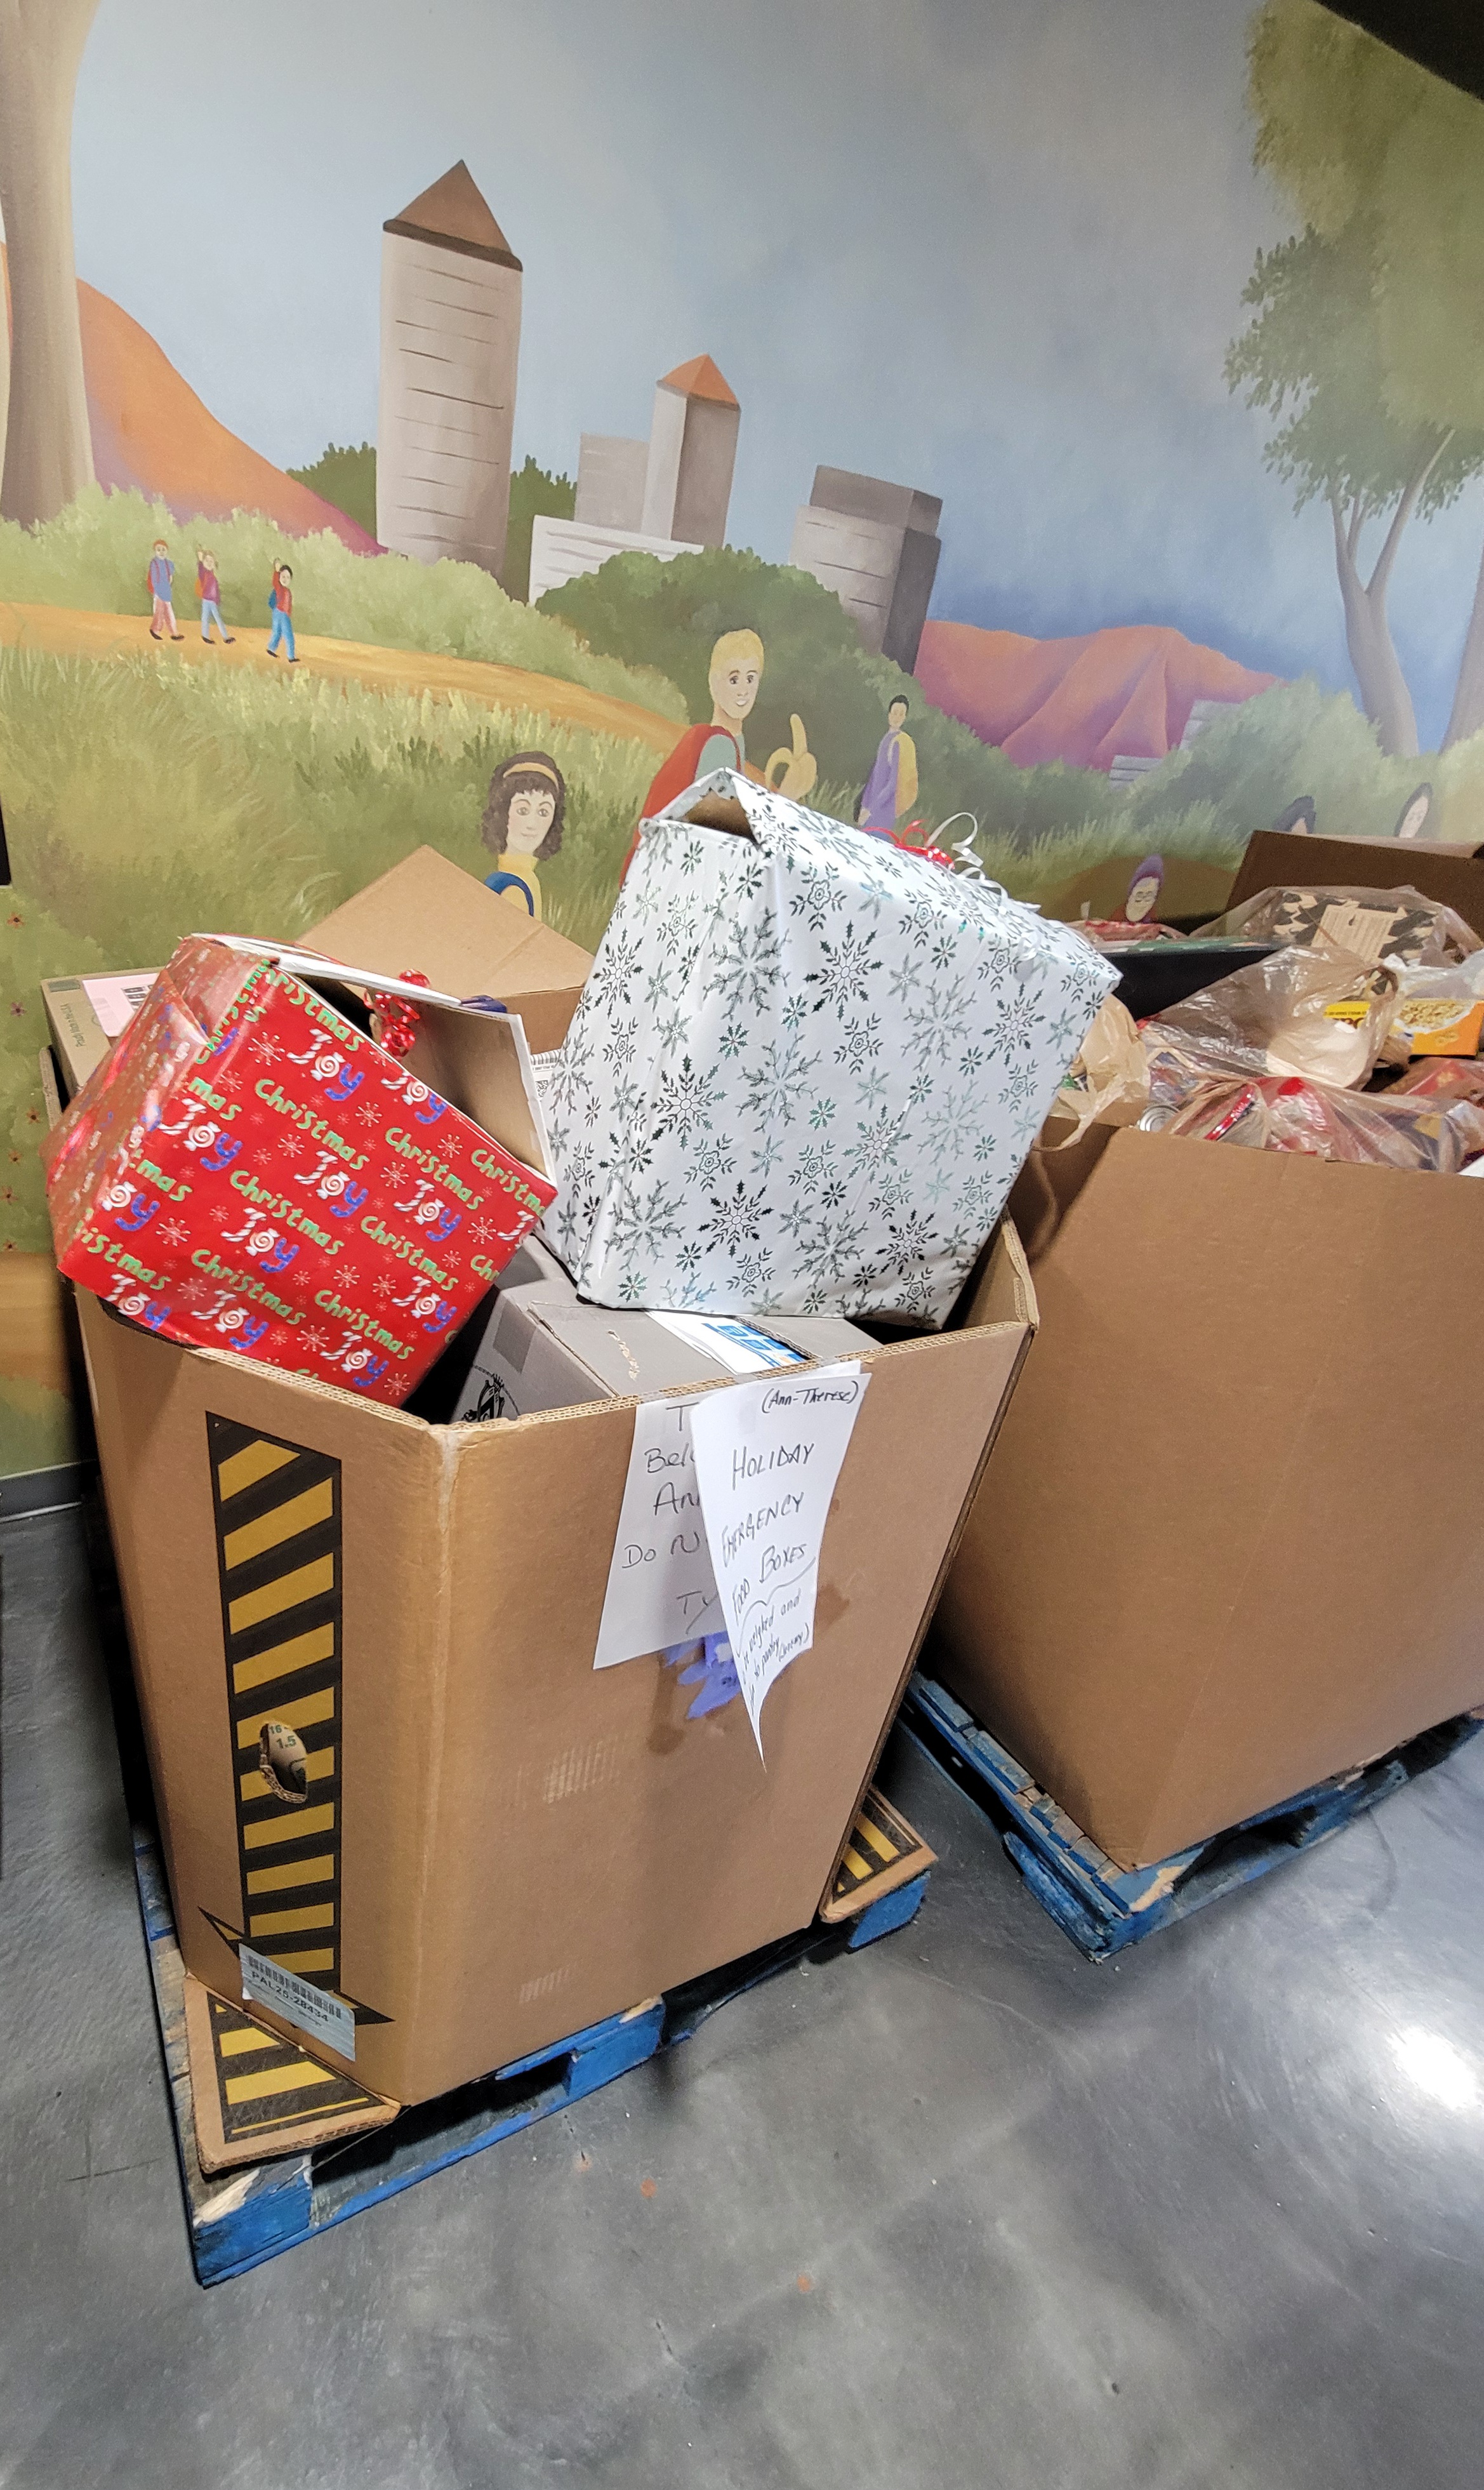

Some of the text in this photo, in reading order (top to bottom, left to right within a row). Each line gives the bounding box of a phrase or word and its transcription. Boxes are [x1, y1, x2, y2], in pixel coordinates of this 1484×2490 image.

[287, 1029, 365, 1101] Joy
[158, 1098, 242, 1170] Joy
[255, 1079, 370, 1169] Christmas
[293, 1150, 368, 1217] Joy
[385, 1128, 484, 1210] Christmas
[220, 1207, 300, 1272] Joy
[230, 1170, 344, 1255] Christmas
[394, 1179, 461, 1241] Joy
[192, 1249, 306, 1324] Christmas
[361, 1216, 459, 1291] Christmas
[191, 1290, 269, 1348] Joy
[314, 1290, 415, 1359] Christmas
[392, 1275, 457, 1333] Joy
[319, 1331, 389, 1387] Joy
[732, 1443, 814, 1491] HOLIDAY
[621, 1543, 656, 1569] Do
[759, 1543, 807, 1584] BOXES
[781, 1587, 801, 1616] and
